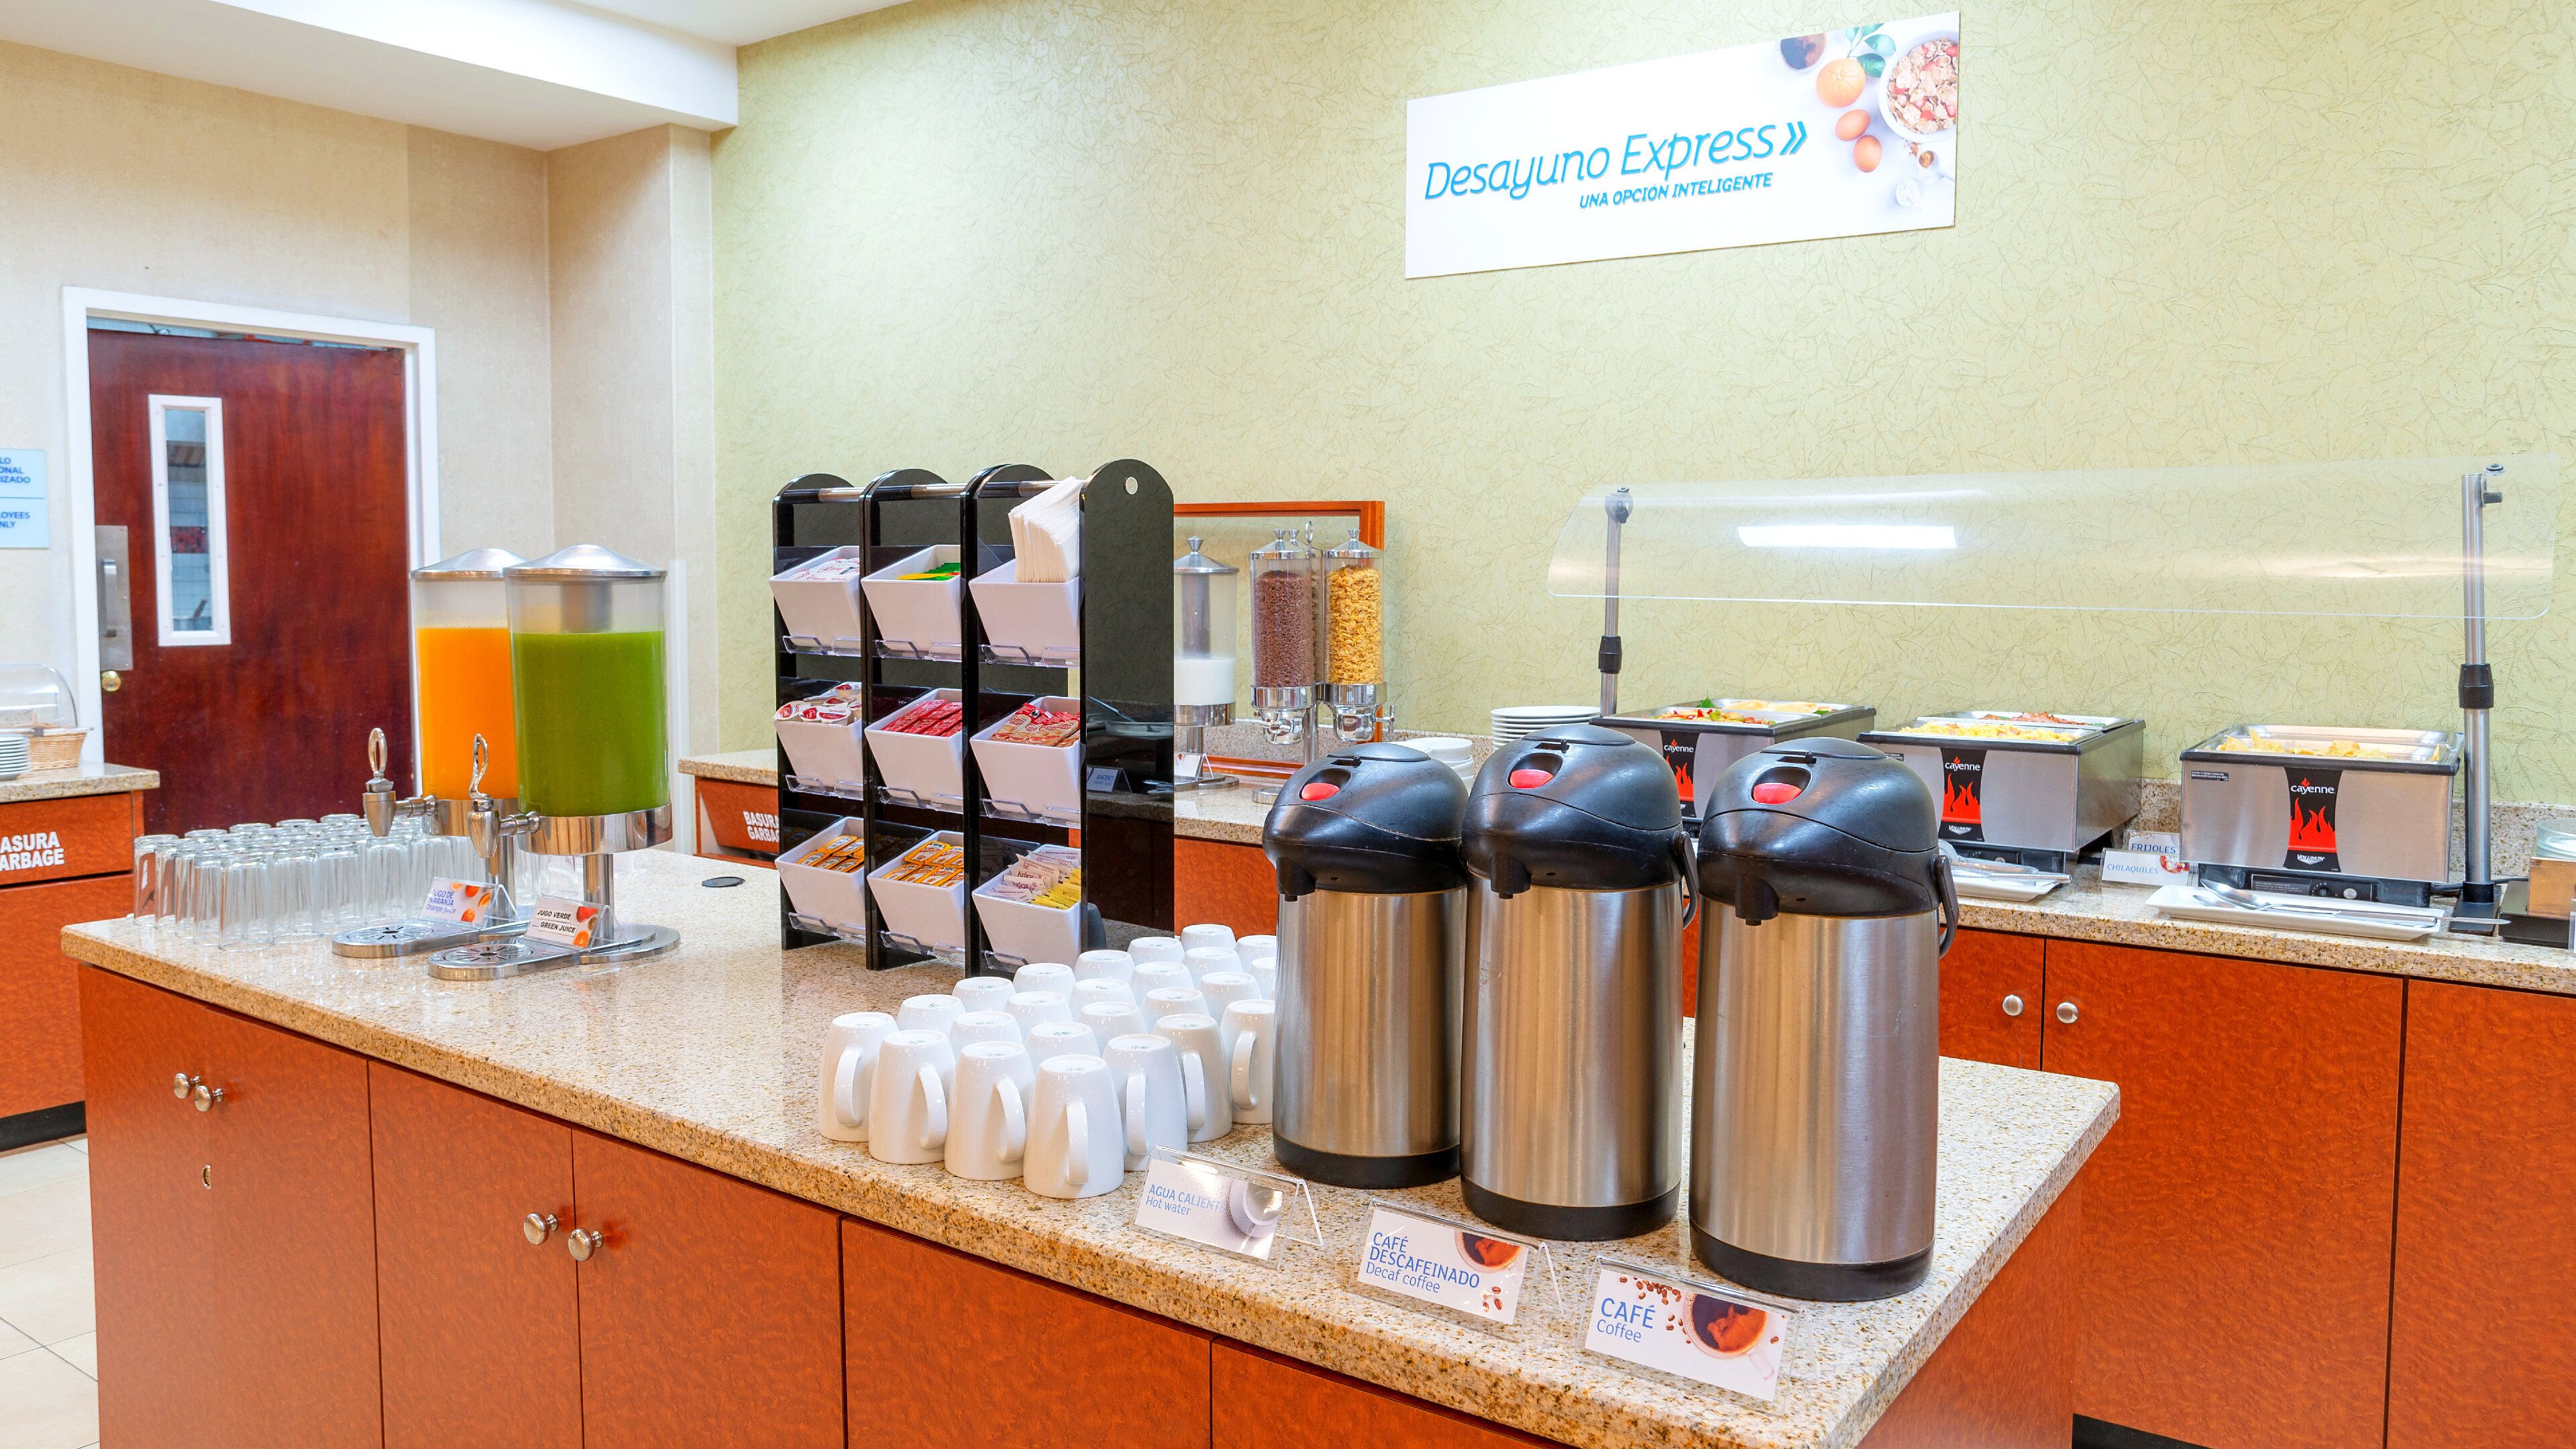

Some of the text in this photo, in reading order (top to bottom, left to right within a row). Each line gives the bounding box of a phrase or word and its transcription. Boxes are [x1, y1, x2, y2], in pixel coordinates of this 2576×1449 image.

[1424, 124, 1777, 201] Desayuno Express
[1579, 192, 1609, 209] UNA
[1672, 172, 1774, 199] INTELIGENTE
[0, 466, 24, 474] ONAL
[1664, 745, 1694, 753] cayenne
[1945, 762, 1980, 771] cayenne
[2290, 785, 2334, 794] cayenne
[0, 831, 60, 853] ASURA
[747, 826, 780, 843] GARBAG
[2131, 843, 2176, 854] FRIJOLES
[0, 848, 64, 871] ARBAGE
[2107, 863, 2159, 875] CHILAQUILES
[429, 898, 453, 906] NARANJA
[432, 889, 446, 898] UGO
[426, 904, 443, 913] Orange
[553, 912, 572, 920] VERDE
[540, 922, 559, 930] GREEN
[1148, 1184, 1175, 1201] AGUA
[1146, 1195, 1191, 1216] Hot water
[1373, 1232, 1409, 1253] CAFÉ
[1369, 1246, 1480, 1289] DESCAFEINADO
[1366, 1262, 1440, 1293] Decaf coffee
[1601, 1297, 1656, 1330] CAFÉ
[1597, 1319, 1642, 1343] Coffee
